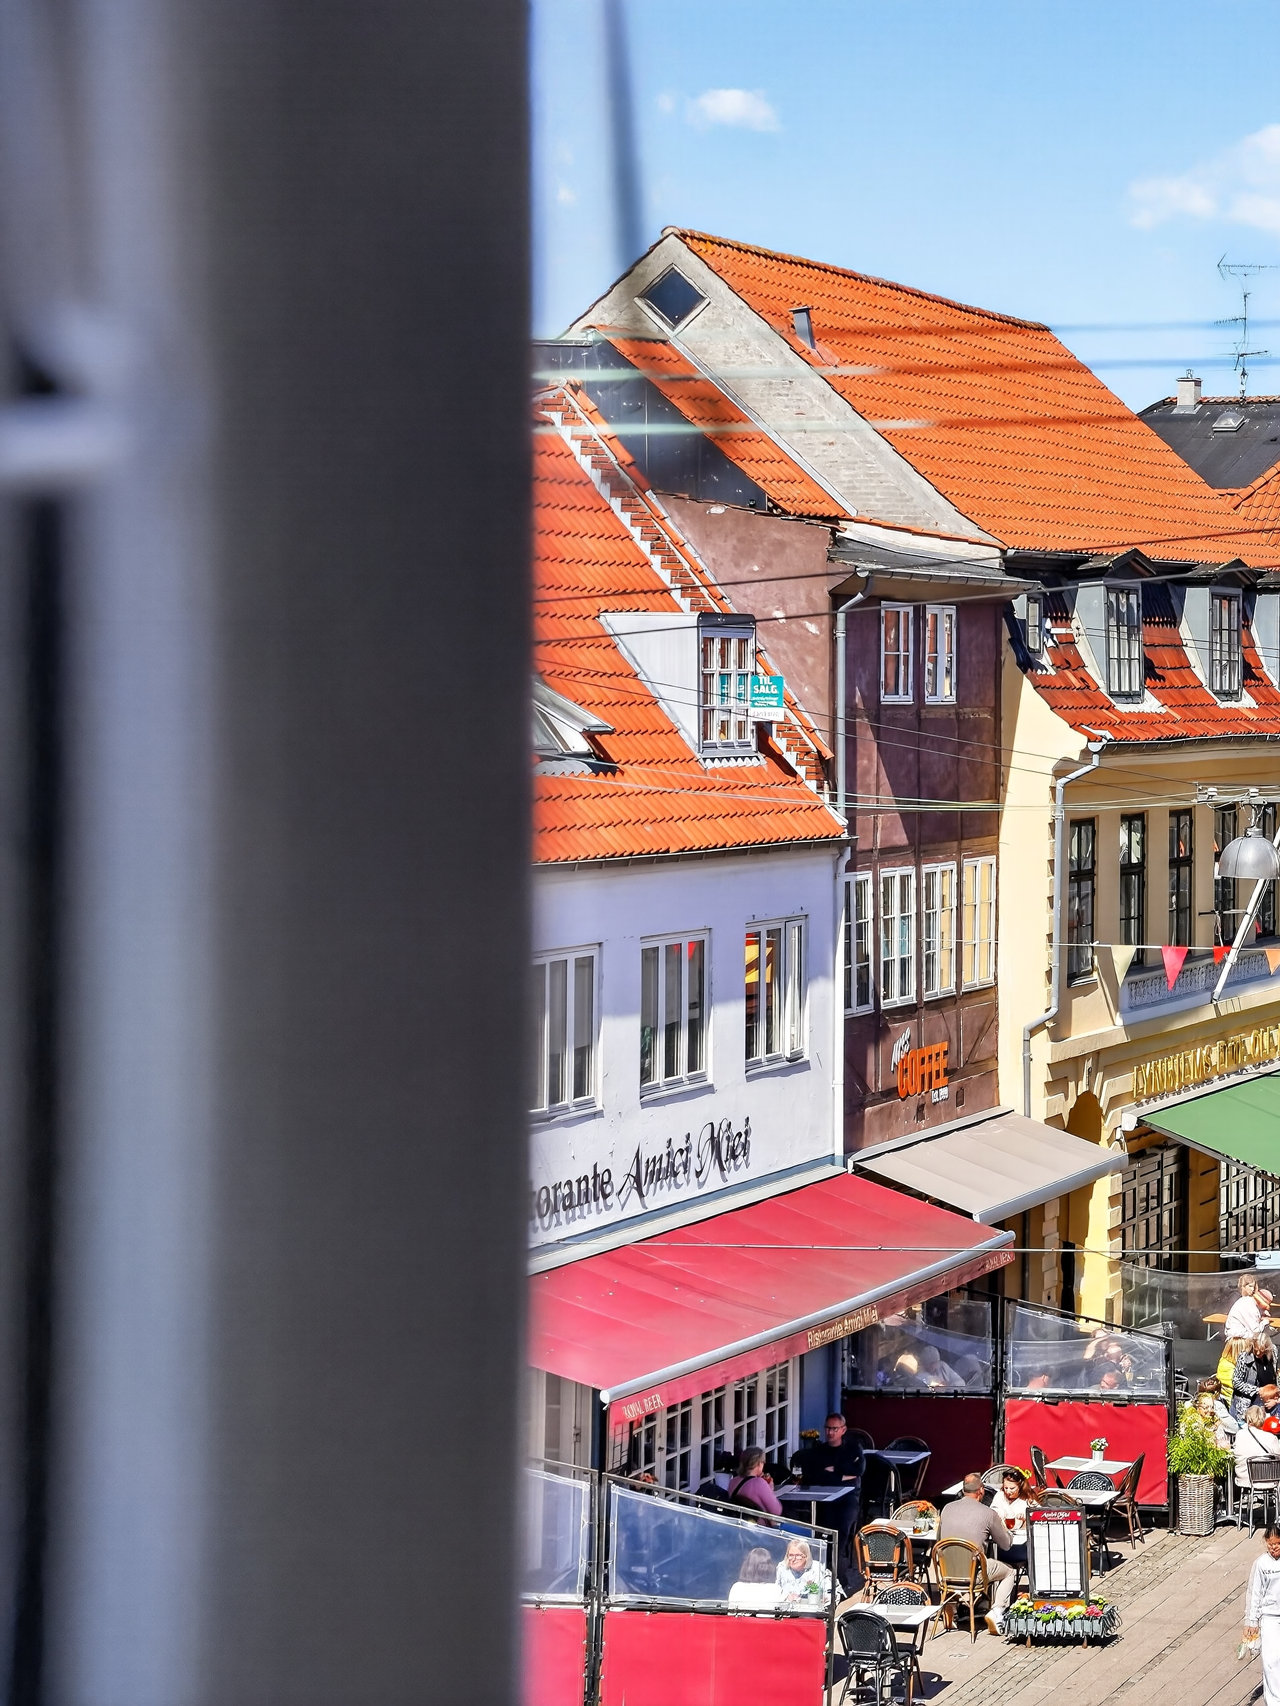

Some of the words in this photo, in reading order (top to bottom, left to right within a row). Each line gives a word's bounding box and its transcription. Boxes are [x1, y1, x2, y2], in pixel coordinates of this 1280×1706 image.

[753, 685, 779, 695] SALG
[759, 676, 773, 685] TIL
[898, 1041, 950, 1099] COFFEE
[530, 1161, 612, 1219] orante
[616, 1132, 692, 1199] Amici
[695, 1116, 751, 1179] Miei
[807, 1322, 843, 1349] Ristorante
[643, 1394, 665, 1412] BEER
